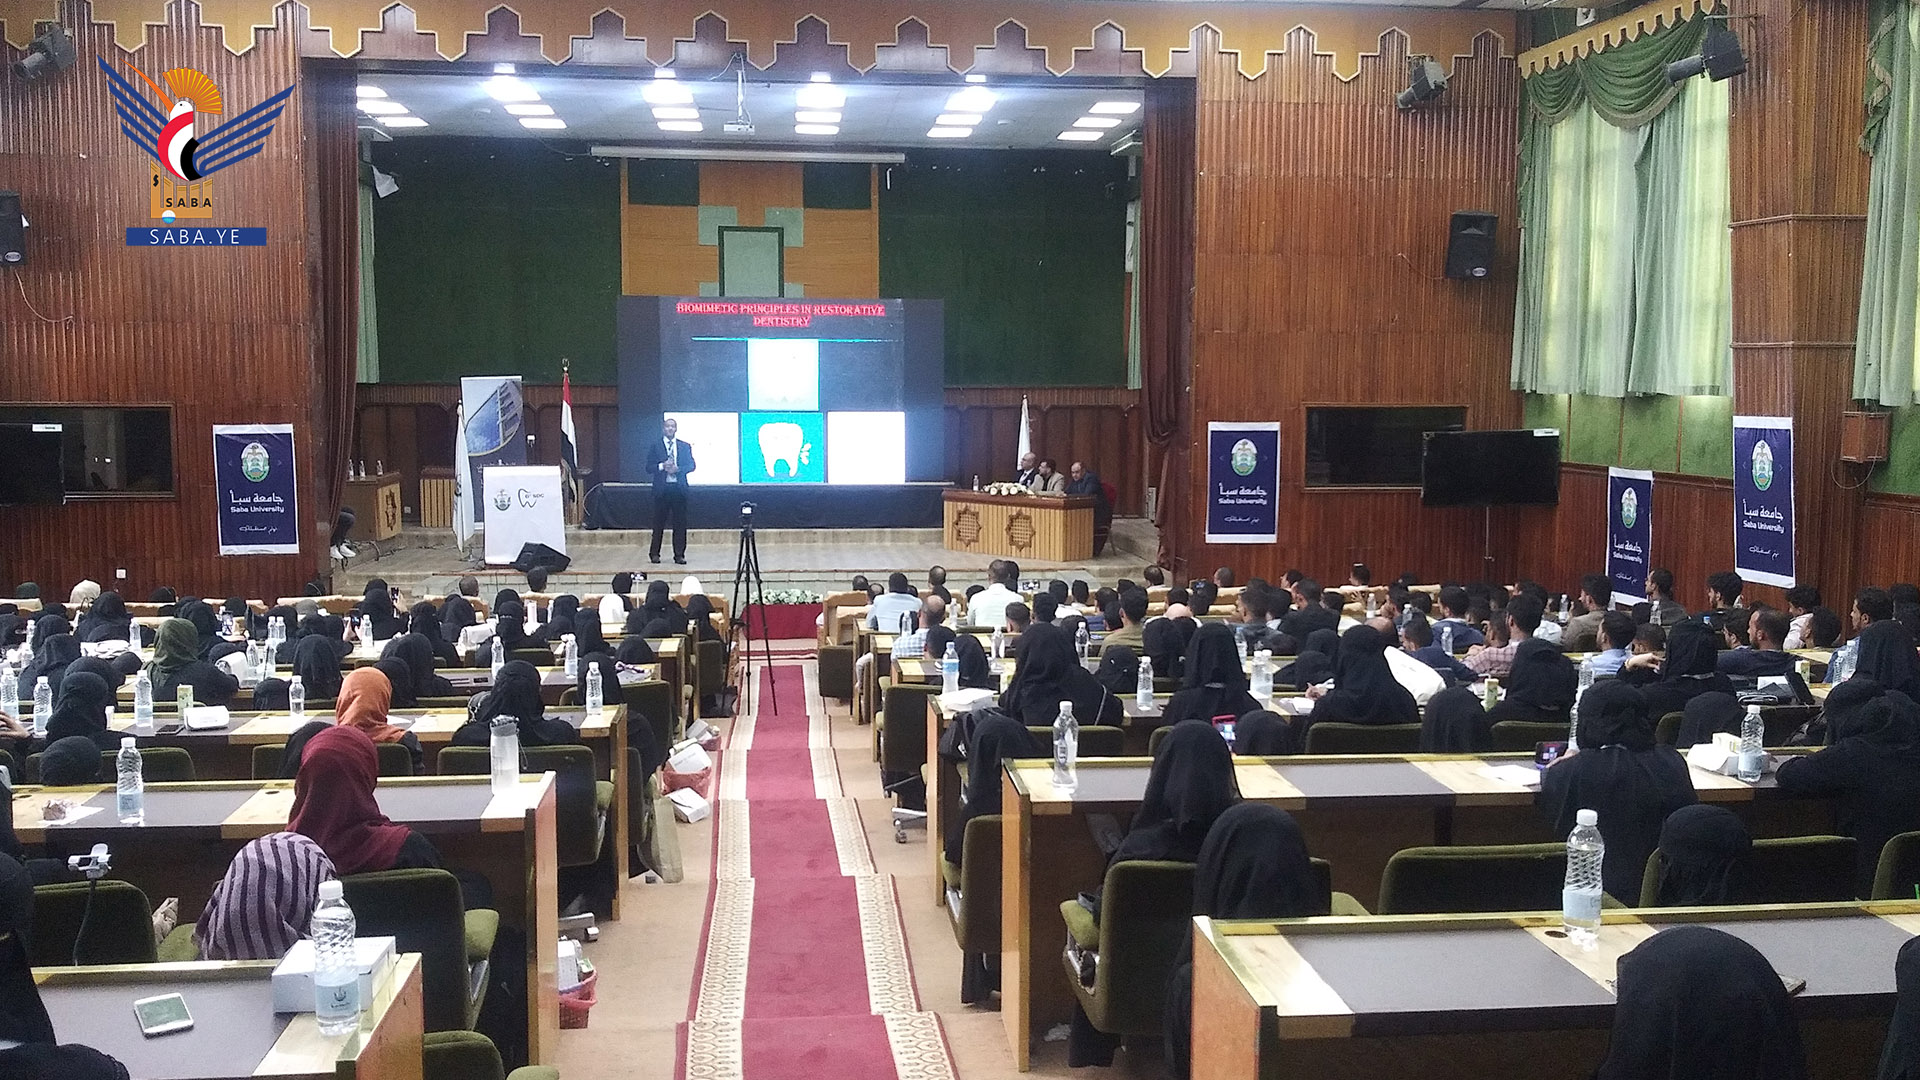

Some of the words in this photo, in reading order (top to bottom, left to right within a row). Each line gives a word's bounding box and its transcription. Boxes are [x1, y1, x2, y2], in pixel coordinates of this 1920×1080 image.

[676, 303, 738, 314] BIOMIMETIC
[739, 304, 800, 314] PRINCIPLES
[801, 304, 812, 314] IN
[813, 304, 885, 316] RESTORATIVE
[753, 316, 810, 326] DENTISTRY
[1218, 482, 1238, 497] سبأ
[1239, 485, 1268, 498] جامعة
[229, 489, 252, 505] سبأ
[253, 492, 284, 505] جامعة
[1236, 497, 1268, 505] University
[250, 506, 284, 514] University
[1742, 498, 1759, 519] سبأ
[1760, 505, 1784, 523] جامعة
[1743, 520, 1757, 529] Saba
[1757, 521, 1785, 534] University
